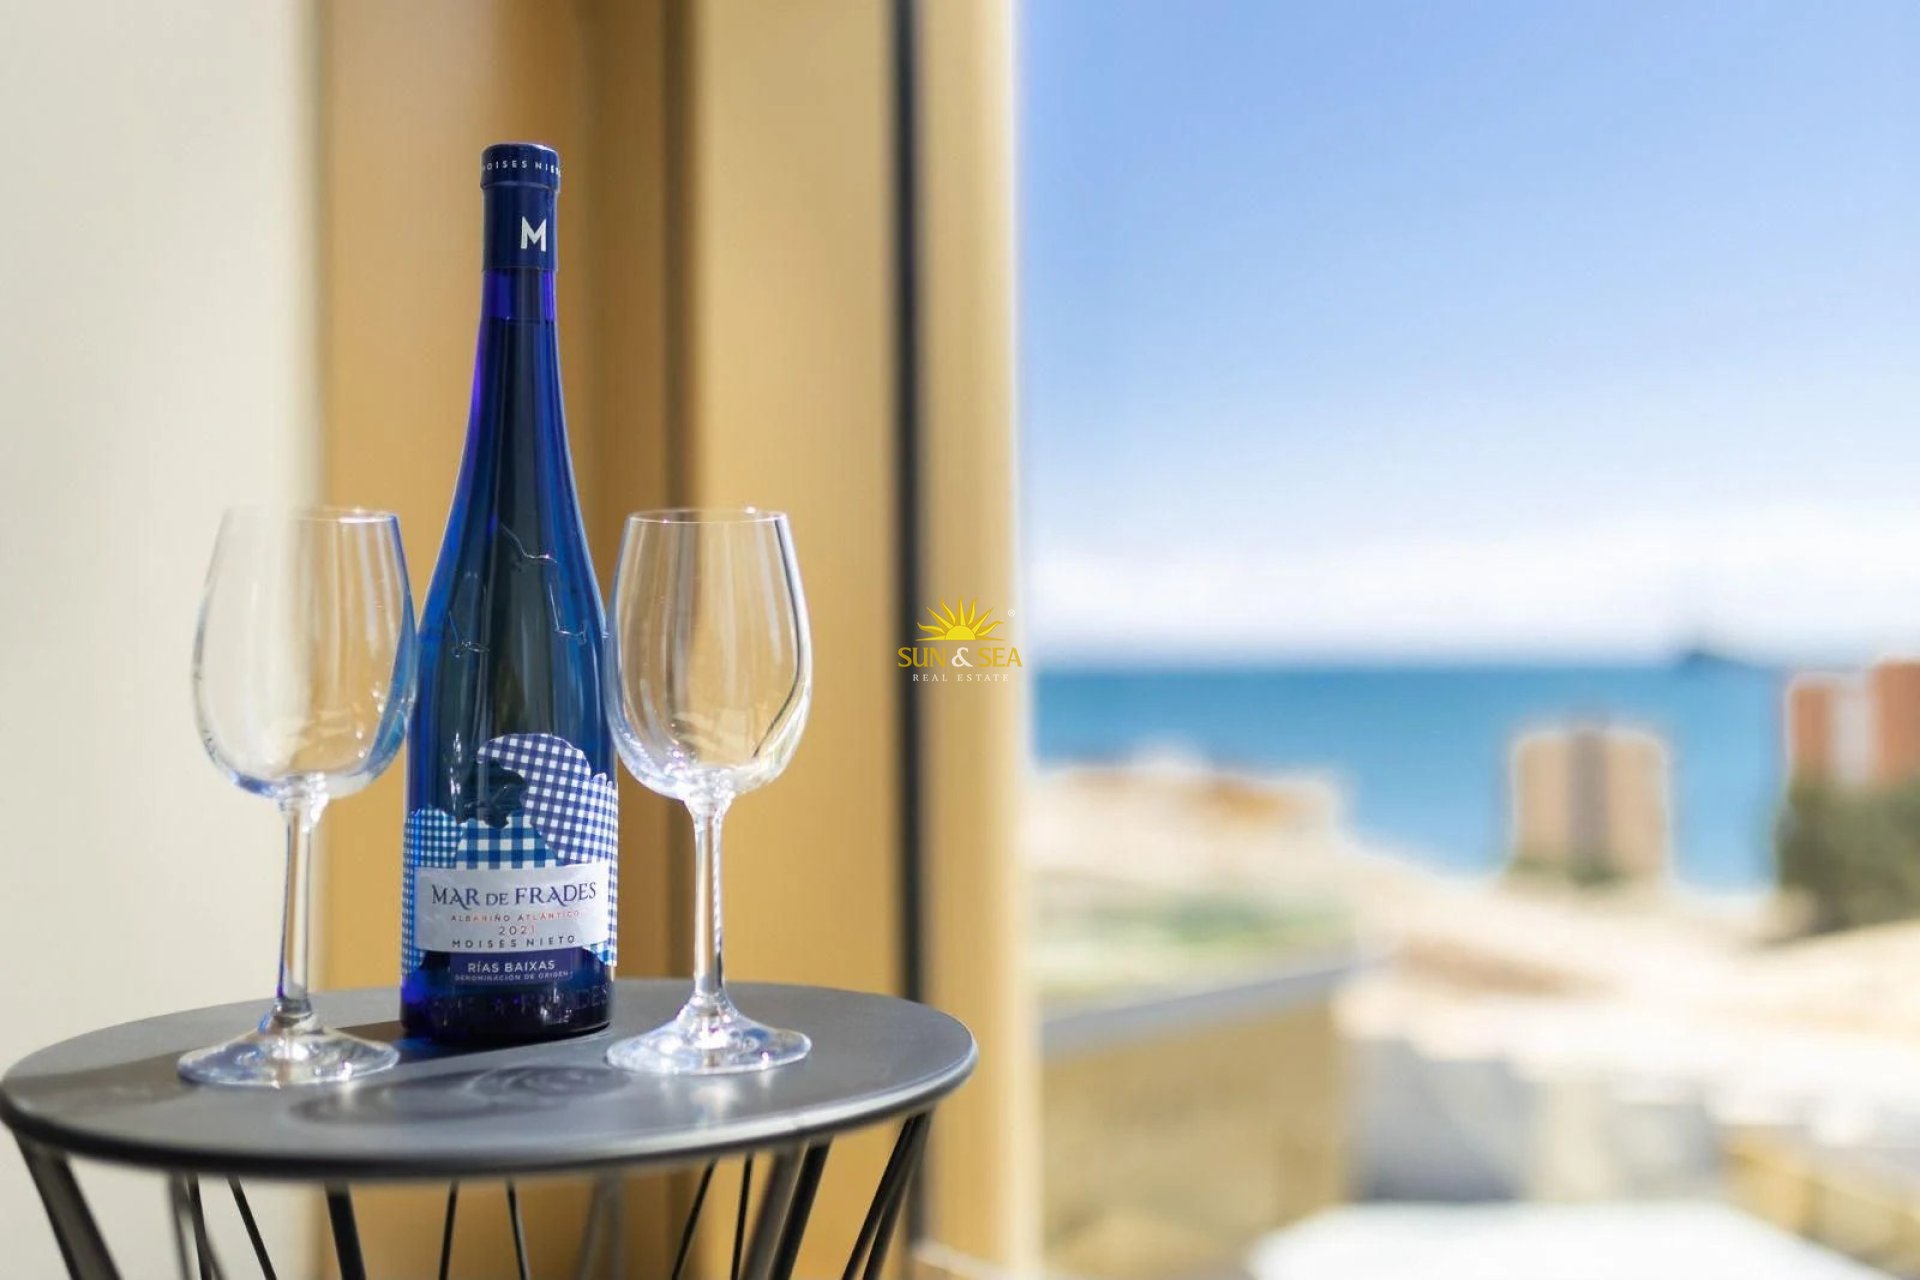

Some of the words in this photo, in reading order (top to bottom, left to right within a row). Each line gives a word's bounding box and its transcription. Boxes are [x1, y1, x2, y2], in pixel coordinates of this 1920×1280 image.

[521, 216, 547, 252] M
[431, 884, 480, 910] MAR
[485, 893, 509, 906] DE
[515, 881, 597, 907] FRADES
[451, 913, 510, 922] ALBARIÑO
[498, 925, 535, 936] 2021
[452, 939, 517, 949] MOISES
[526, 935, 575, 947] NIETO
[467, 961, 499, 974] RÍAS
[504, 960, 556, 973] BAIXAS
